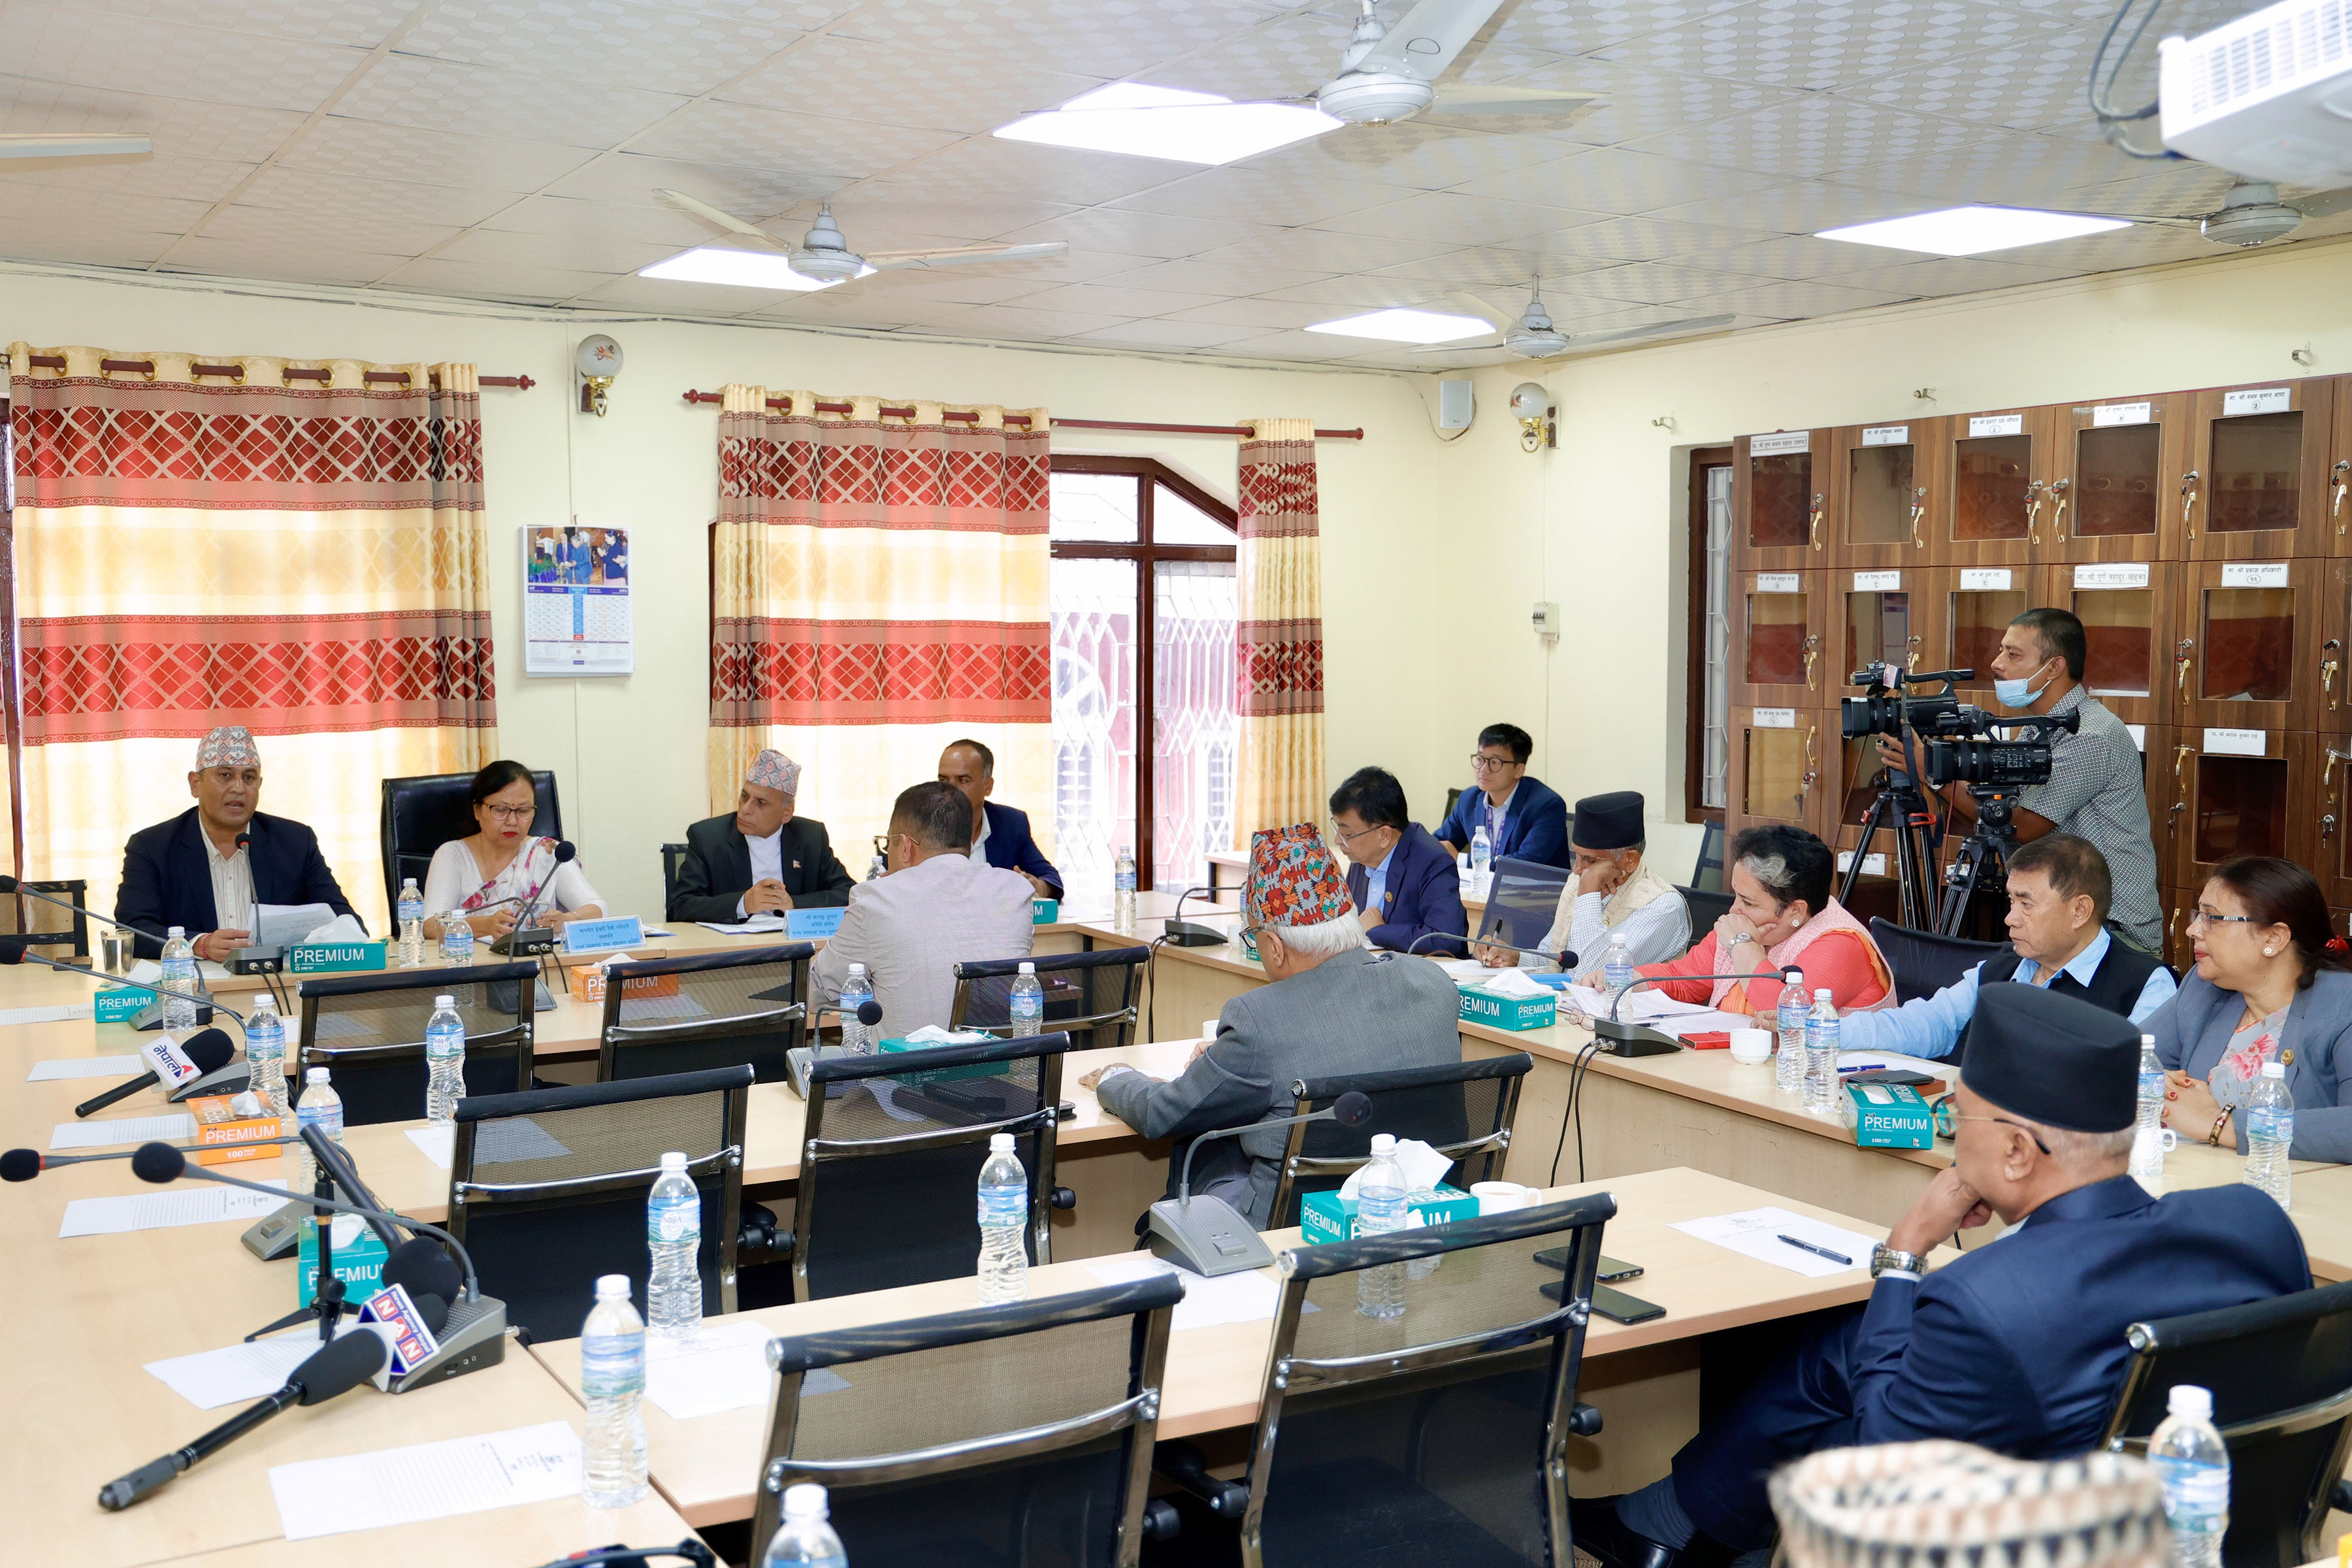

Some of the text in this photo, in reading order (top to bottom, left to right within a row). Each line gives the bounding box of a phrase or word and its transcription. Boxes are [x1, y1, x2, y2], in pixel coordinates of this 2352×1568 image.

[295, 948, 365, 963] PREMIUM
[588, 976, 659, 992] PRMIUM
[99, 997, 152, 1008] PREMIUM
[1460, 995, 1499, 1017] REMIUM
[1518, 1002, 1553, 1017] PREMIUM
[154, 1045, 182, 1073] नेपाल
[1865, 1117, 1927, 1130] PREMIUM
[206, 1125, 276, 1144] PREMIUM
[227, 1150, 244, 1159] 100
[1303, 1206, 1341, 1237] PREMIUM
[309, 1264, 385, 1287] PEMIU
[391, 1290, 432, 1353] News Agency Nepal
